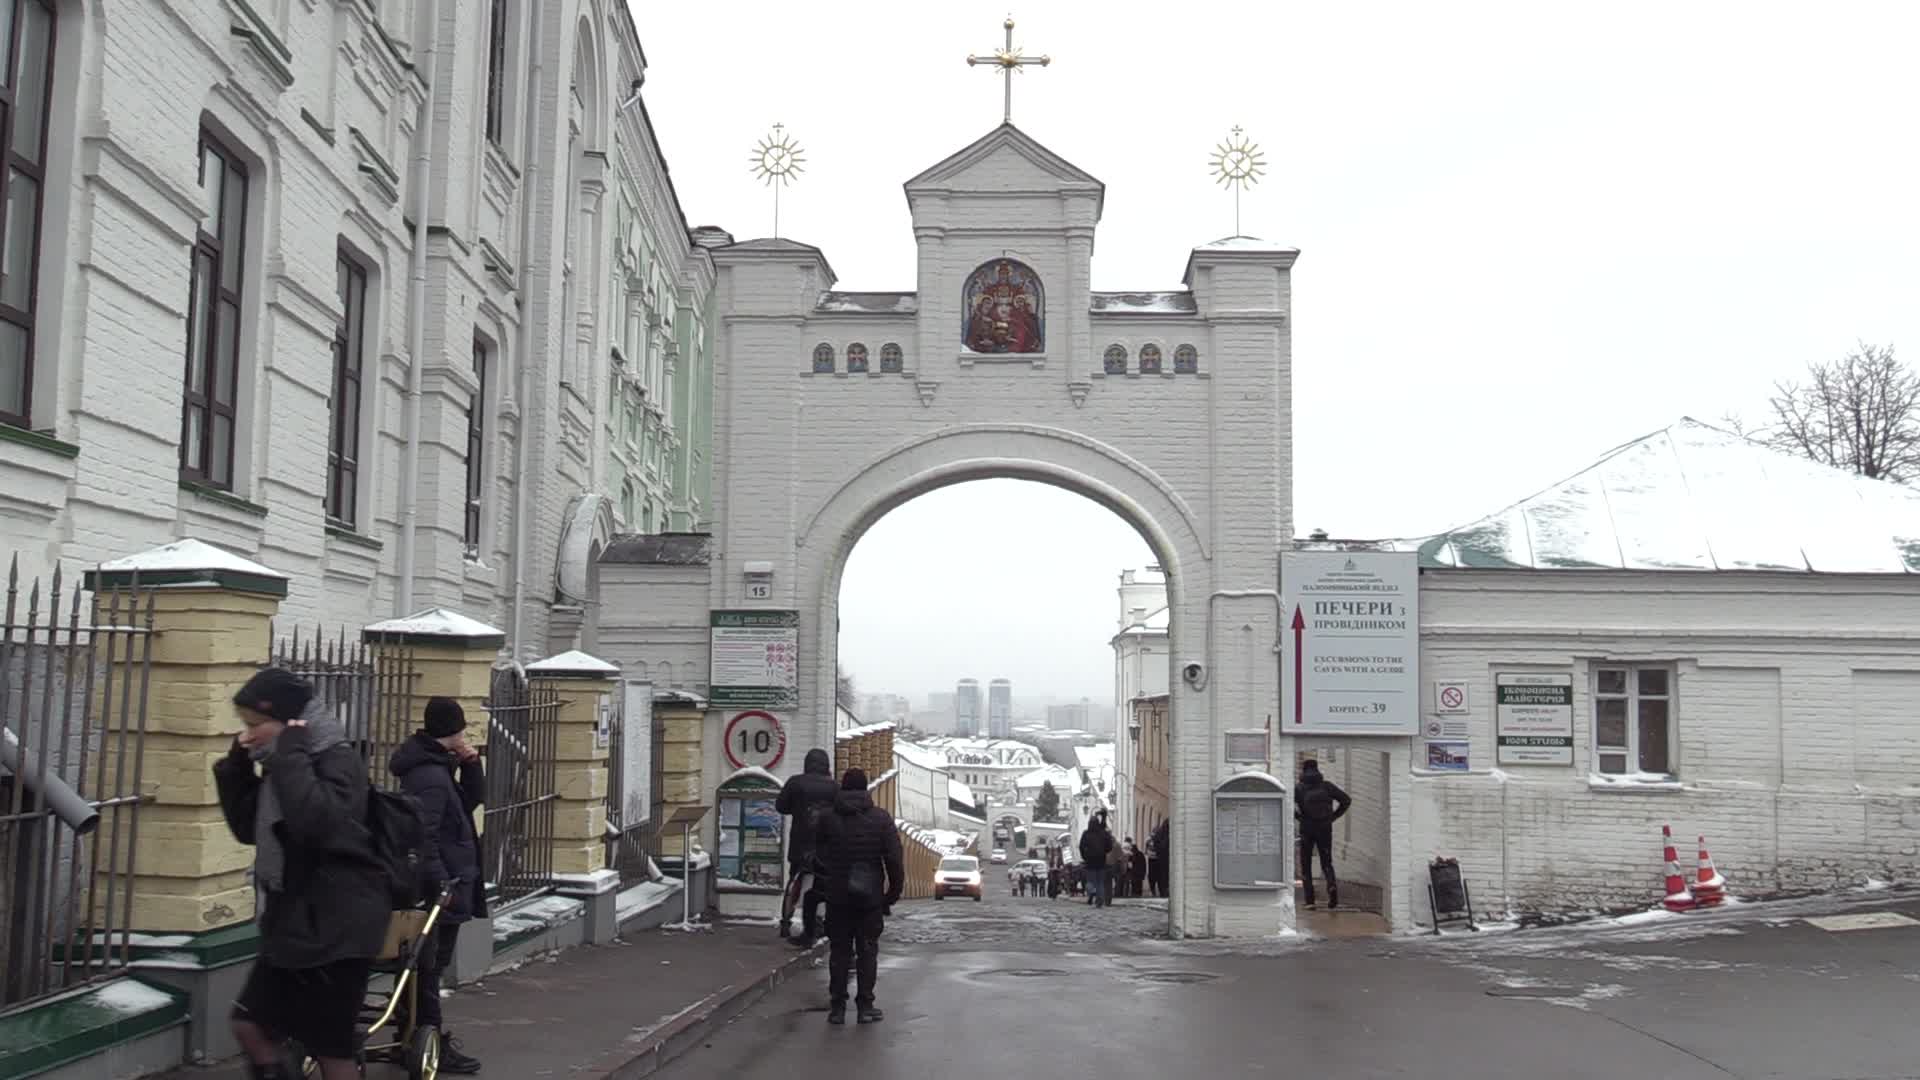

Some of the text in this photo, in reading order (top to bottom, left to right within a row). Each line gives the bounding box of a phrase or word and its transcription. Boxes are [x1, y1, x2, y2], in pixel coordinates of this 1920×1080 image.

[752, 587, 766, 596] 15
[1314, 601, 1393, 616] ПЕЧЕРИ
[1314, 620, 1406, 630] ПРОВІДНИКОМ
[1313, 655, 1370, 663] EXCURSIONS
[1313, 665, 1342, 673] CAVES
[1371, 703, 1387, 713] 39
[738, 730, 770, 753] 10
[1529, 737, 1566, 745] STUDIO
